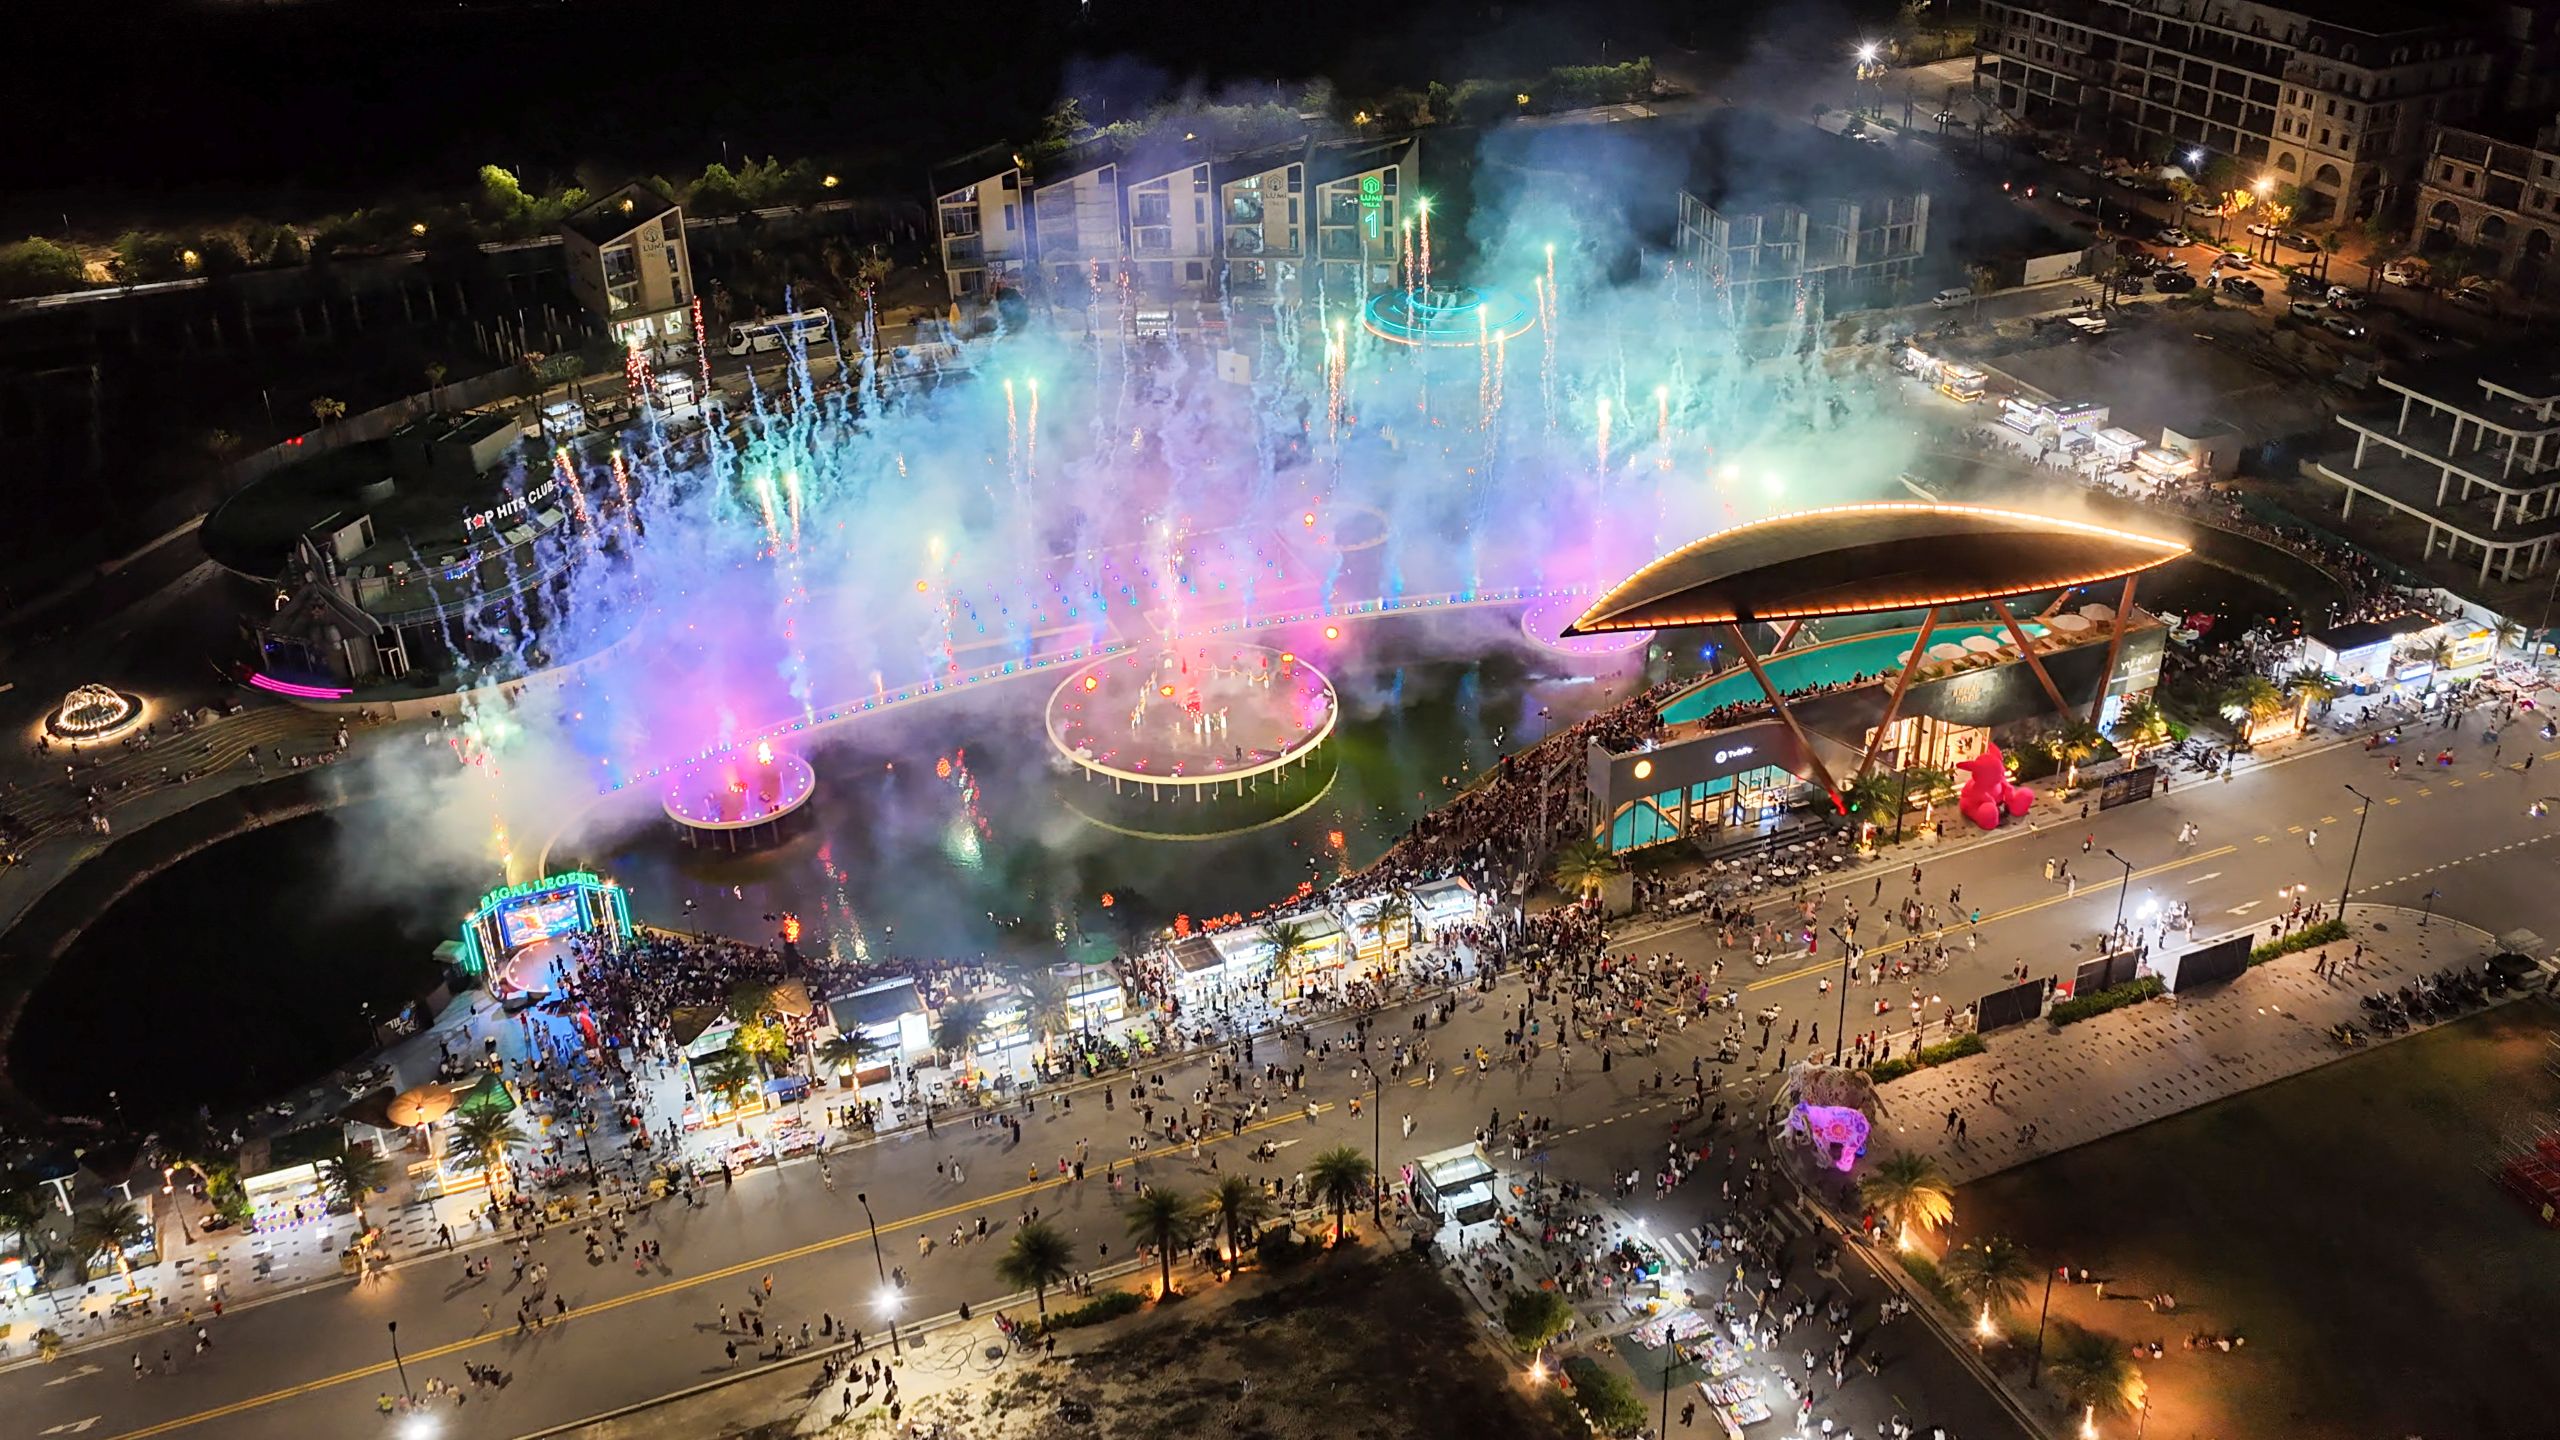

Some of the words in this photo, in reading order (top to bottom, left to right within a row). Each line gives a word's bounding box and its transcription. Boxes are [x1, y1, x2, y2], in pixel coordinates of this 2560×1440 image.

[1360, 194, 1383, 202] LUMI
[1365, 210, 1377, 238] 1
[496, 497, 527, 519] HITS
[528, 479, 555, 504] CLUB
[481, 882, 532, 907] REGAL
[534, 872, 599, 892] LEGEND
